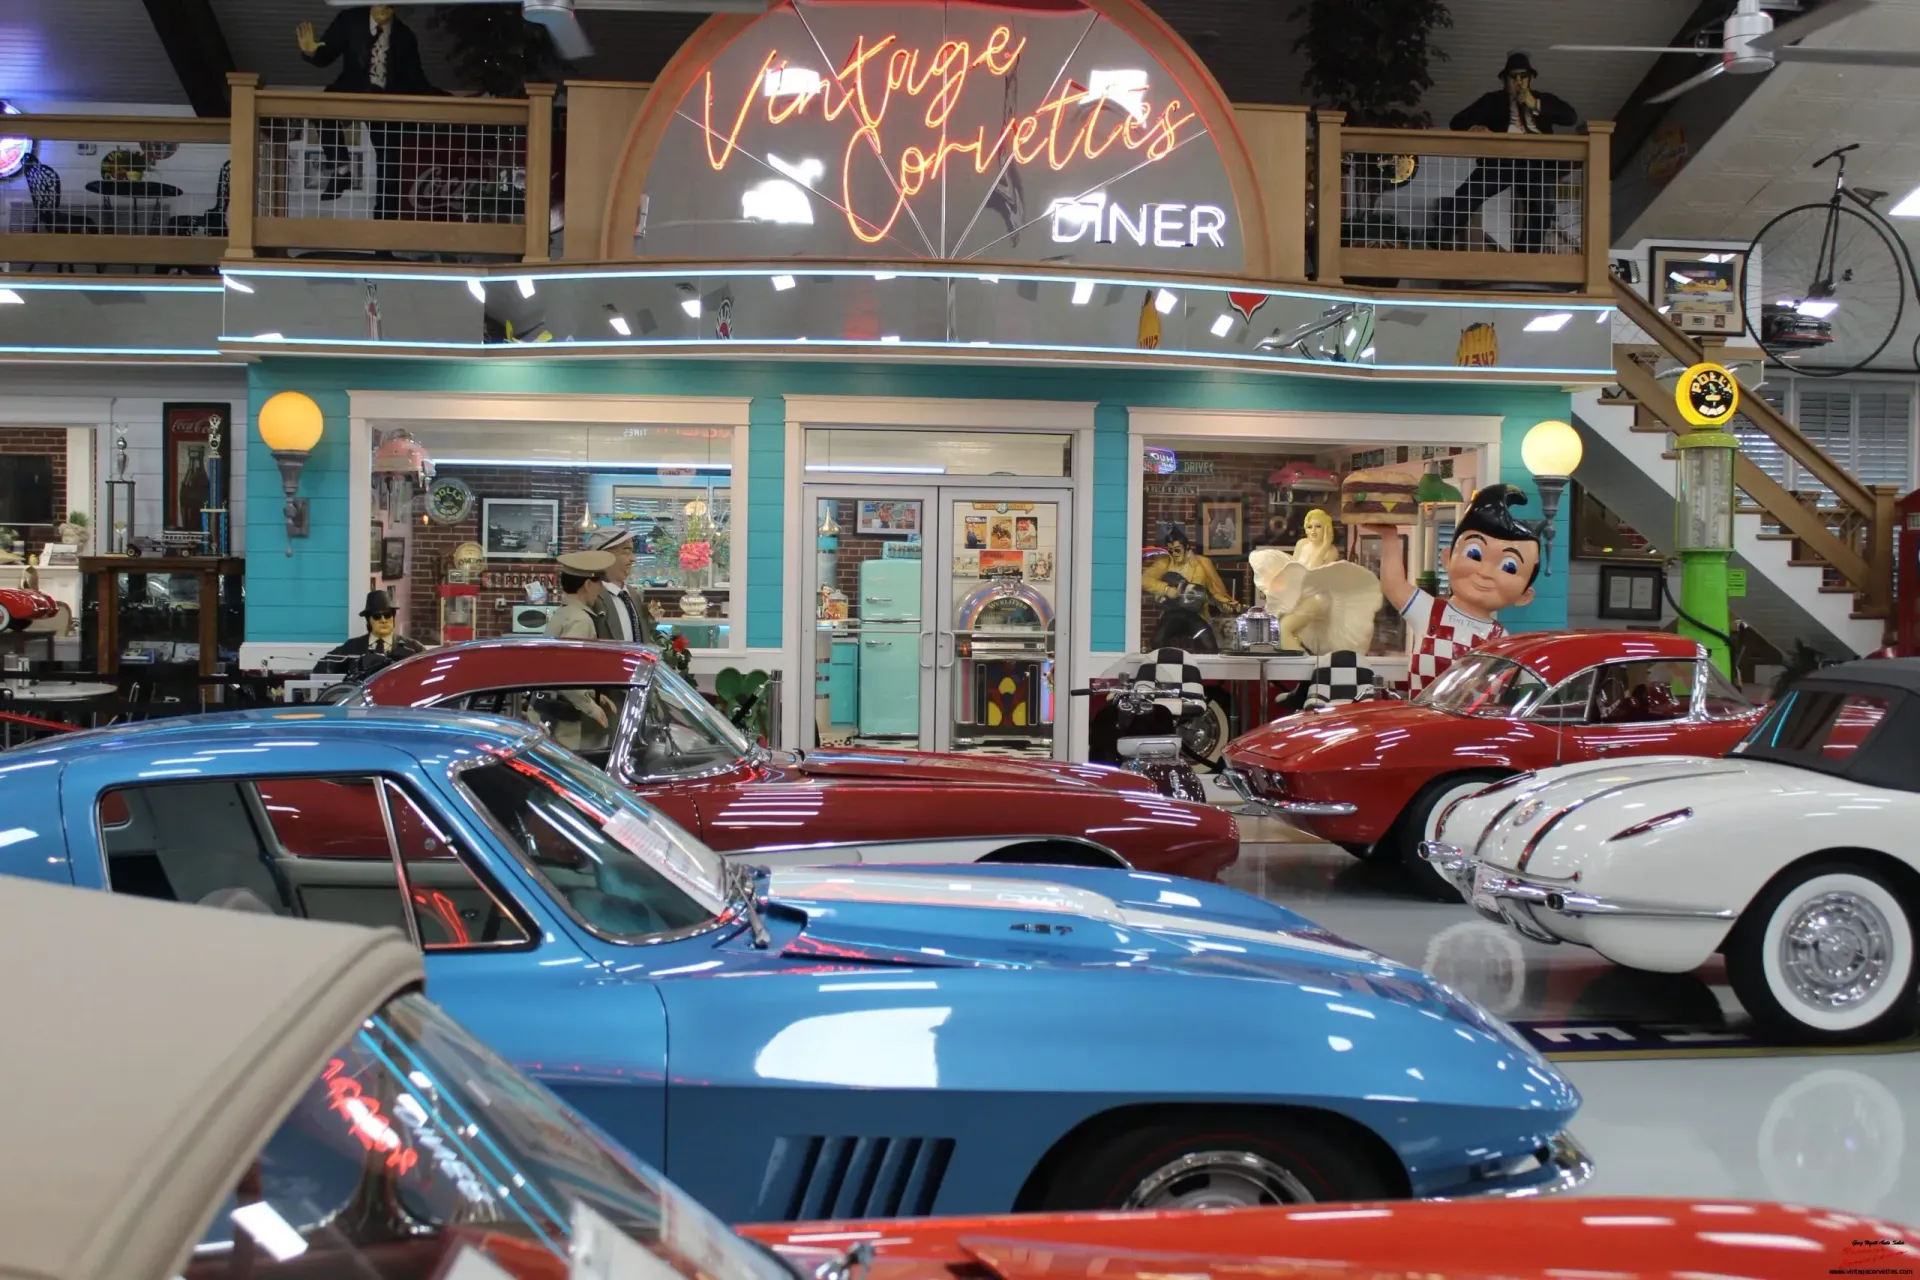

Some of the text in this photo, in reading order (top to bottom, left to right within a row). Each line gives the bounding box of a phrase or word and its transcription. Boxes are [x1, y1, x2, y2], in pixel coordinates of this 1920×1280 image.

[705, 25, 1027, 171] Vintage
[842, 78, 1196, 243] Corvettes
[1050, 200, 1227, 248] DINER
[1691, 372, 1733, 393] POLLY
